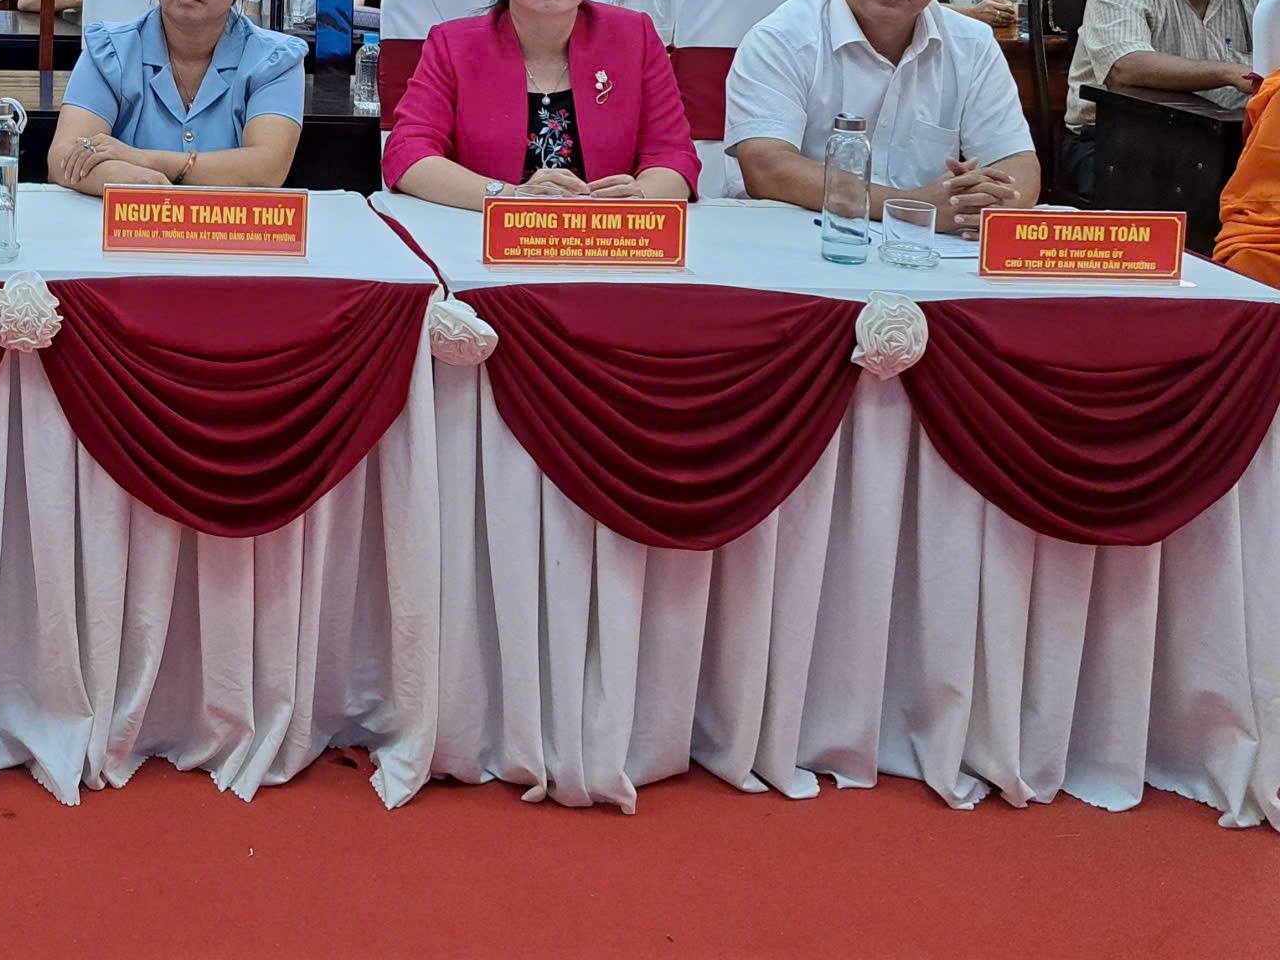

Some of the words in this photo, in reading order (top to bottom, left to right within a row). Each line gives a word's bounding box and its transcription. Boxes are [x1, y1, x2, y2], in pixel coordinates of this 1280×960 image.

[114, 198, 184, 222] NGUYỄN
[190, 206, 247, 224] THANH
[252, 204, 296, 225] THÚY
[504, 212, 558, 228] DƯƠNG
[562, 213, 586, 232] THỊ
[591, 214, 621, 229] KIM
[627, 211, 666, 230] THÚY
[1015, 221, 1049, 240] NGÔ
[1053, 225, 1104, 241] THANH
[1109, 222, 1151, 242] TOÀN
[519, 236, 547, 246] THÀNH
[504, 246, 521, 256] CHỦ
[523, 248, 542, 258] TỊCH
[585, 247, 609, 257] NHÂN
[610, 247, 628, 257] DÂN
[629, 247, 664, 258] PHƯỜNG
[1005, 257, 1023, 267] CHỦ
[1024, 259, 1043, 269] TỊCH
[1057, 260, 1076, 269] BAN
[1076, 260, 1101, 270] NHÂN
[1102, 260, 1121, 270] DÂN
